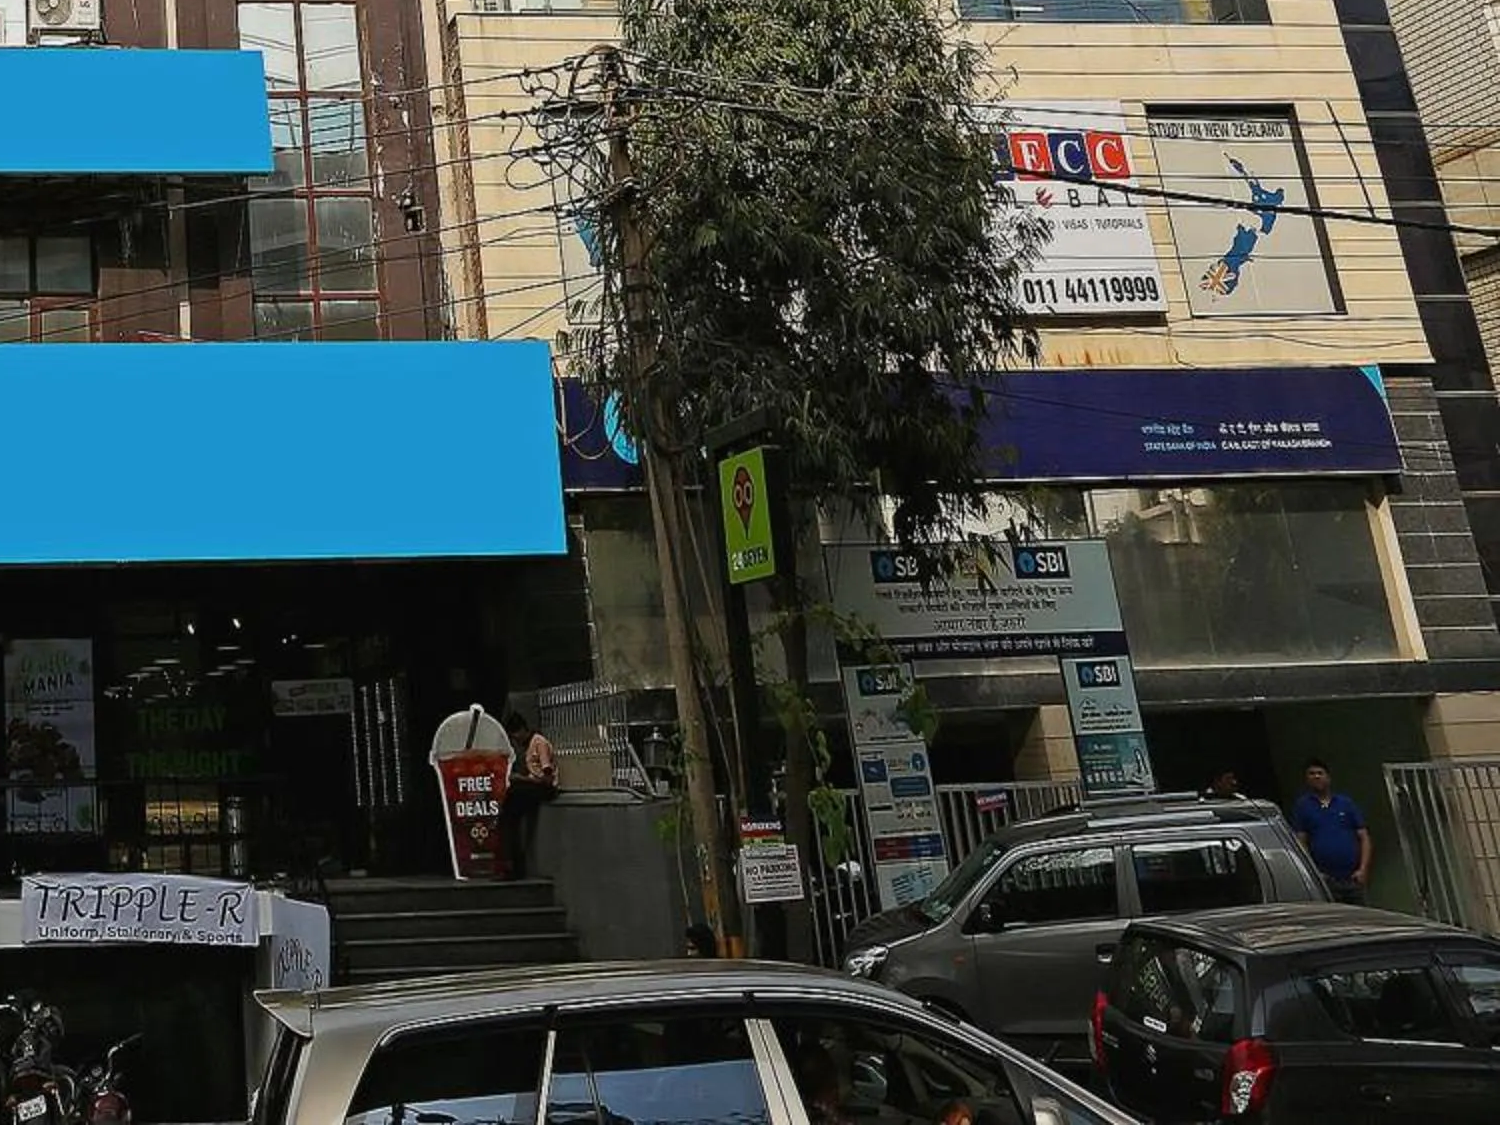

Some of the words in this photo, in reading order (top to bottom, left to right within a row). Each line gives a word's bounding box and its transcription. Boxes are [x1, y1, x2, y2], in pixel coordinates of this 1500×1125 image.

[1204, 122, 1230, 137] NEW
[990, 139, 1124, 175] ECC
[1022, 278, 1058, 304] 011
[1064, 276, 1160, 303] 44119999
[894, 556, 919, 576] SB
[1036, 552, 1066, 573] SBI
[1094, 664, 1117, 683] SBI
[456, 800, 499, 818] DEALS
[745, 865, 759, 876] NO
[760, 862, 796, 874] PARKING
[197, 930, 244, 944] Sports
